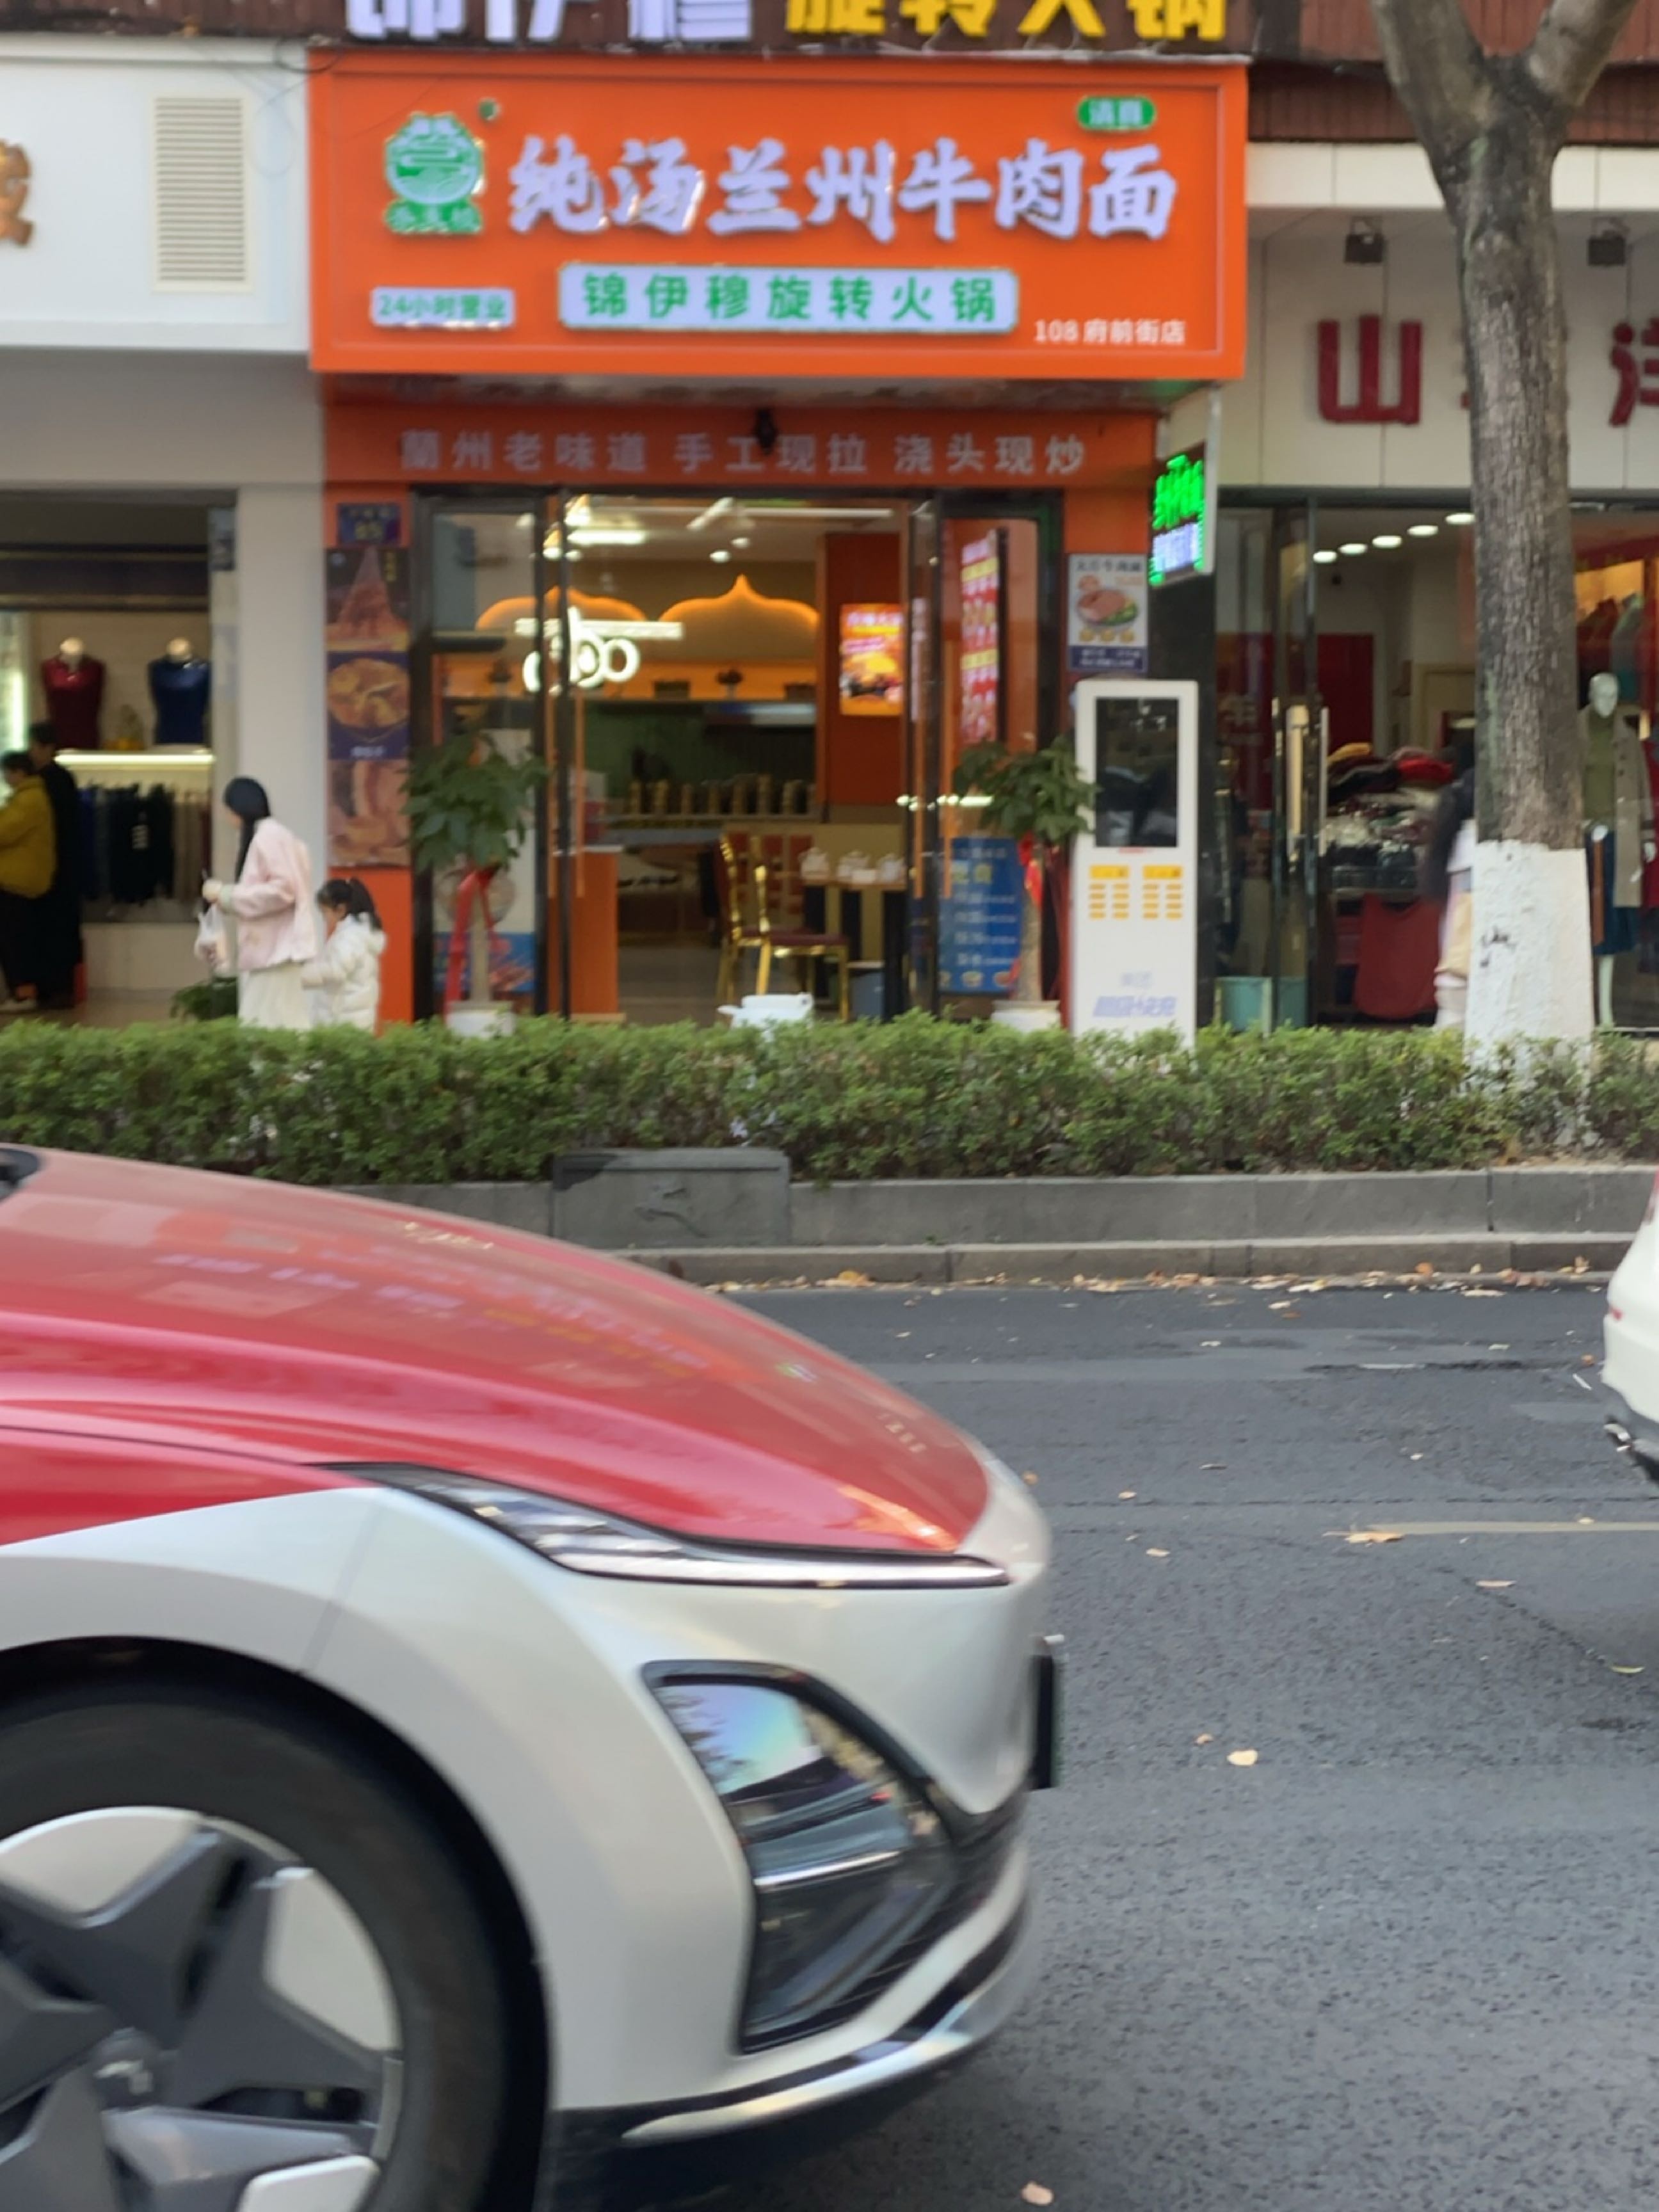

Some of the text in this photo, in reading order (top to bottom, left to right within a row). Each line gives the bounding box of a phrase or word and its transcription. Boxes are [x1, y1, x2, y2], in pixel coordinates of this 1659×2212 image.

[509, 134, 1178, 242] 纯汤兰州牛肉面
[583, 271, 997, 323] 锦伊穆旋转火锅
[894, 433, 1086, 475] 浇头现炒
